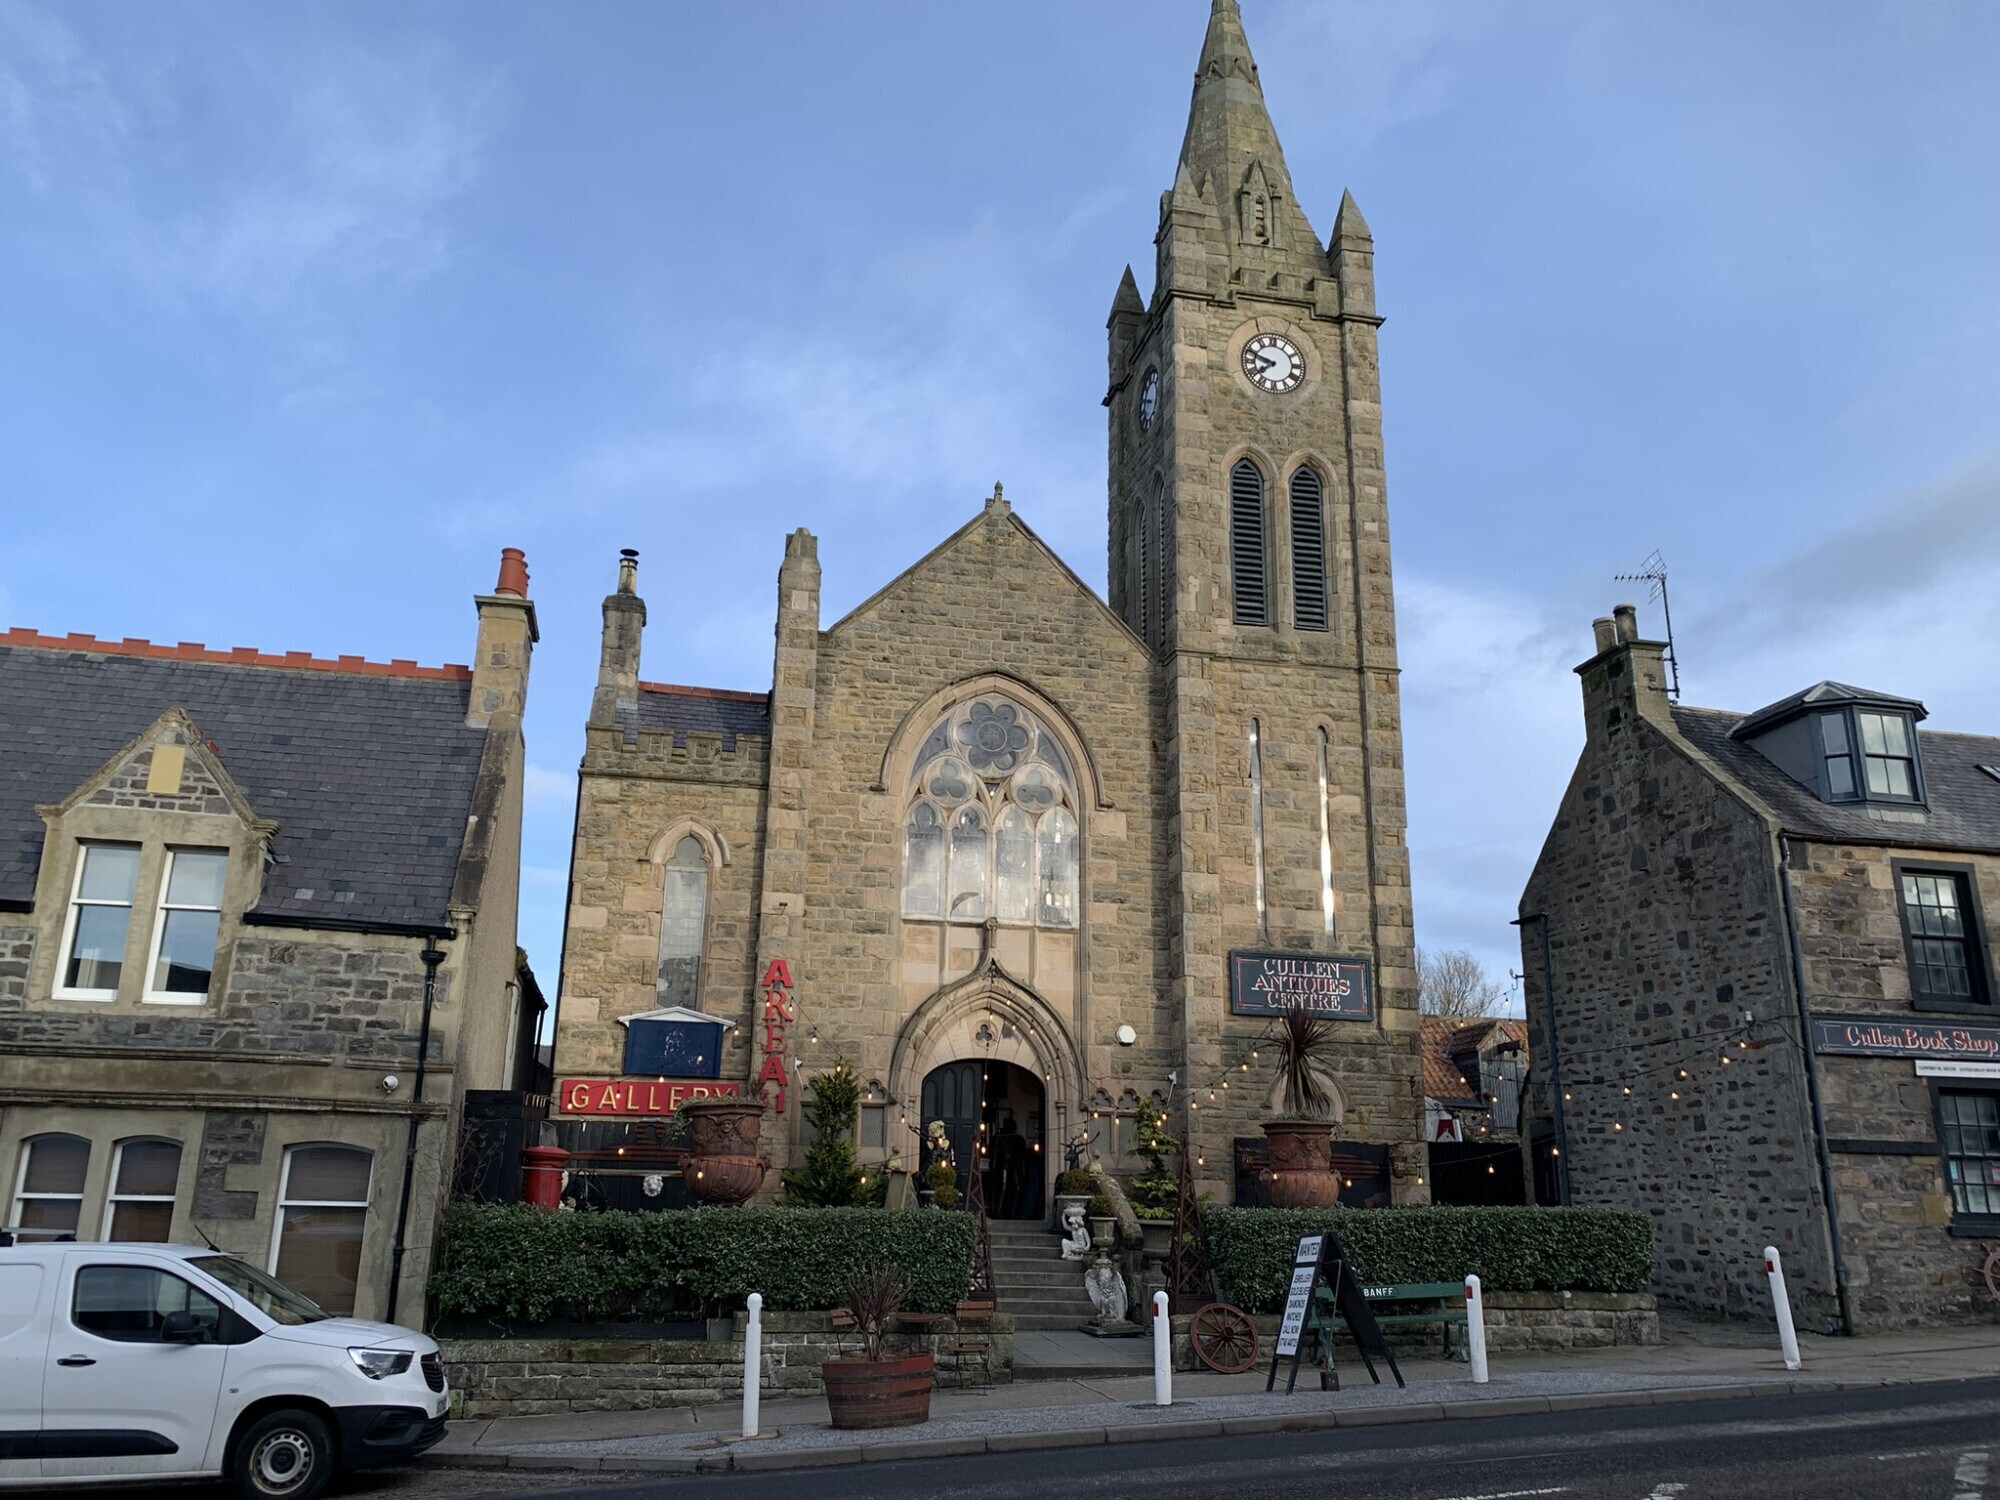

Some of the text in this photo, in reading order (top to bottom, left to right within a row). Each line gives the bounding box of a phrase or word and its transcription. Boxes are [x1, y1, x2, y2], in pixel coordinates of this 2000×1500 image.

[1263, 958, 1340, 978] CULLEN
[1251, 974, 1351, 996] ANTIQUES
[1267, 992, 1341, 1011] CENTRE
[761, 959, 794, 1086] AREA
[1845, 1025, 1999, 1057] Cullen Book Shop
[1363, 1287, 1394, 1297] BANFF
